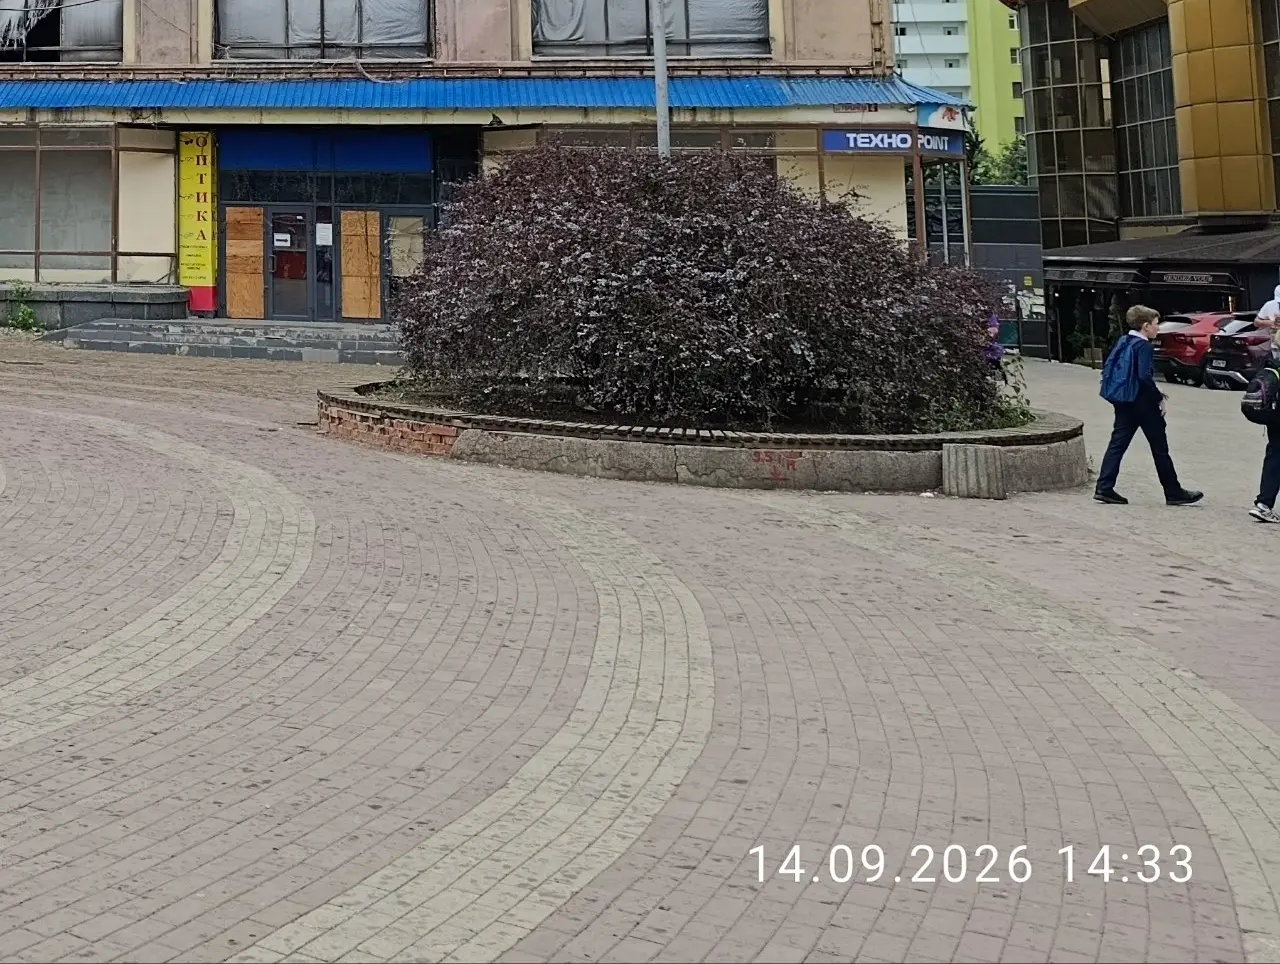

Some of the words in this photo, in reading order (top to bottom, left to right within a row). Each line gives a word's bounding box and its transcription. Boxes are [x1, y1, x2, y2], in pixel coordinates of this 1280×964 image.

[846, 133, 912, 148] ТЕХНО
[917, 134, 949, 151] POINT
[195, 136, 208, 240] ОПТИКА
